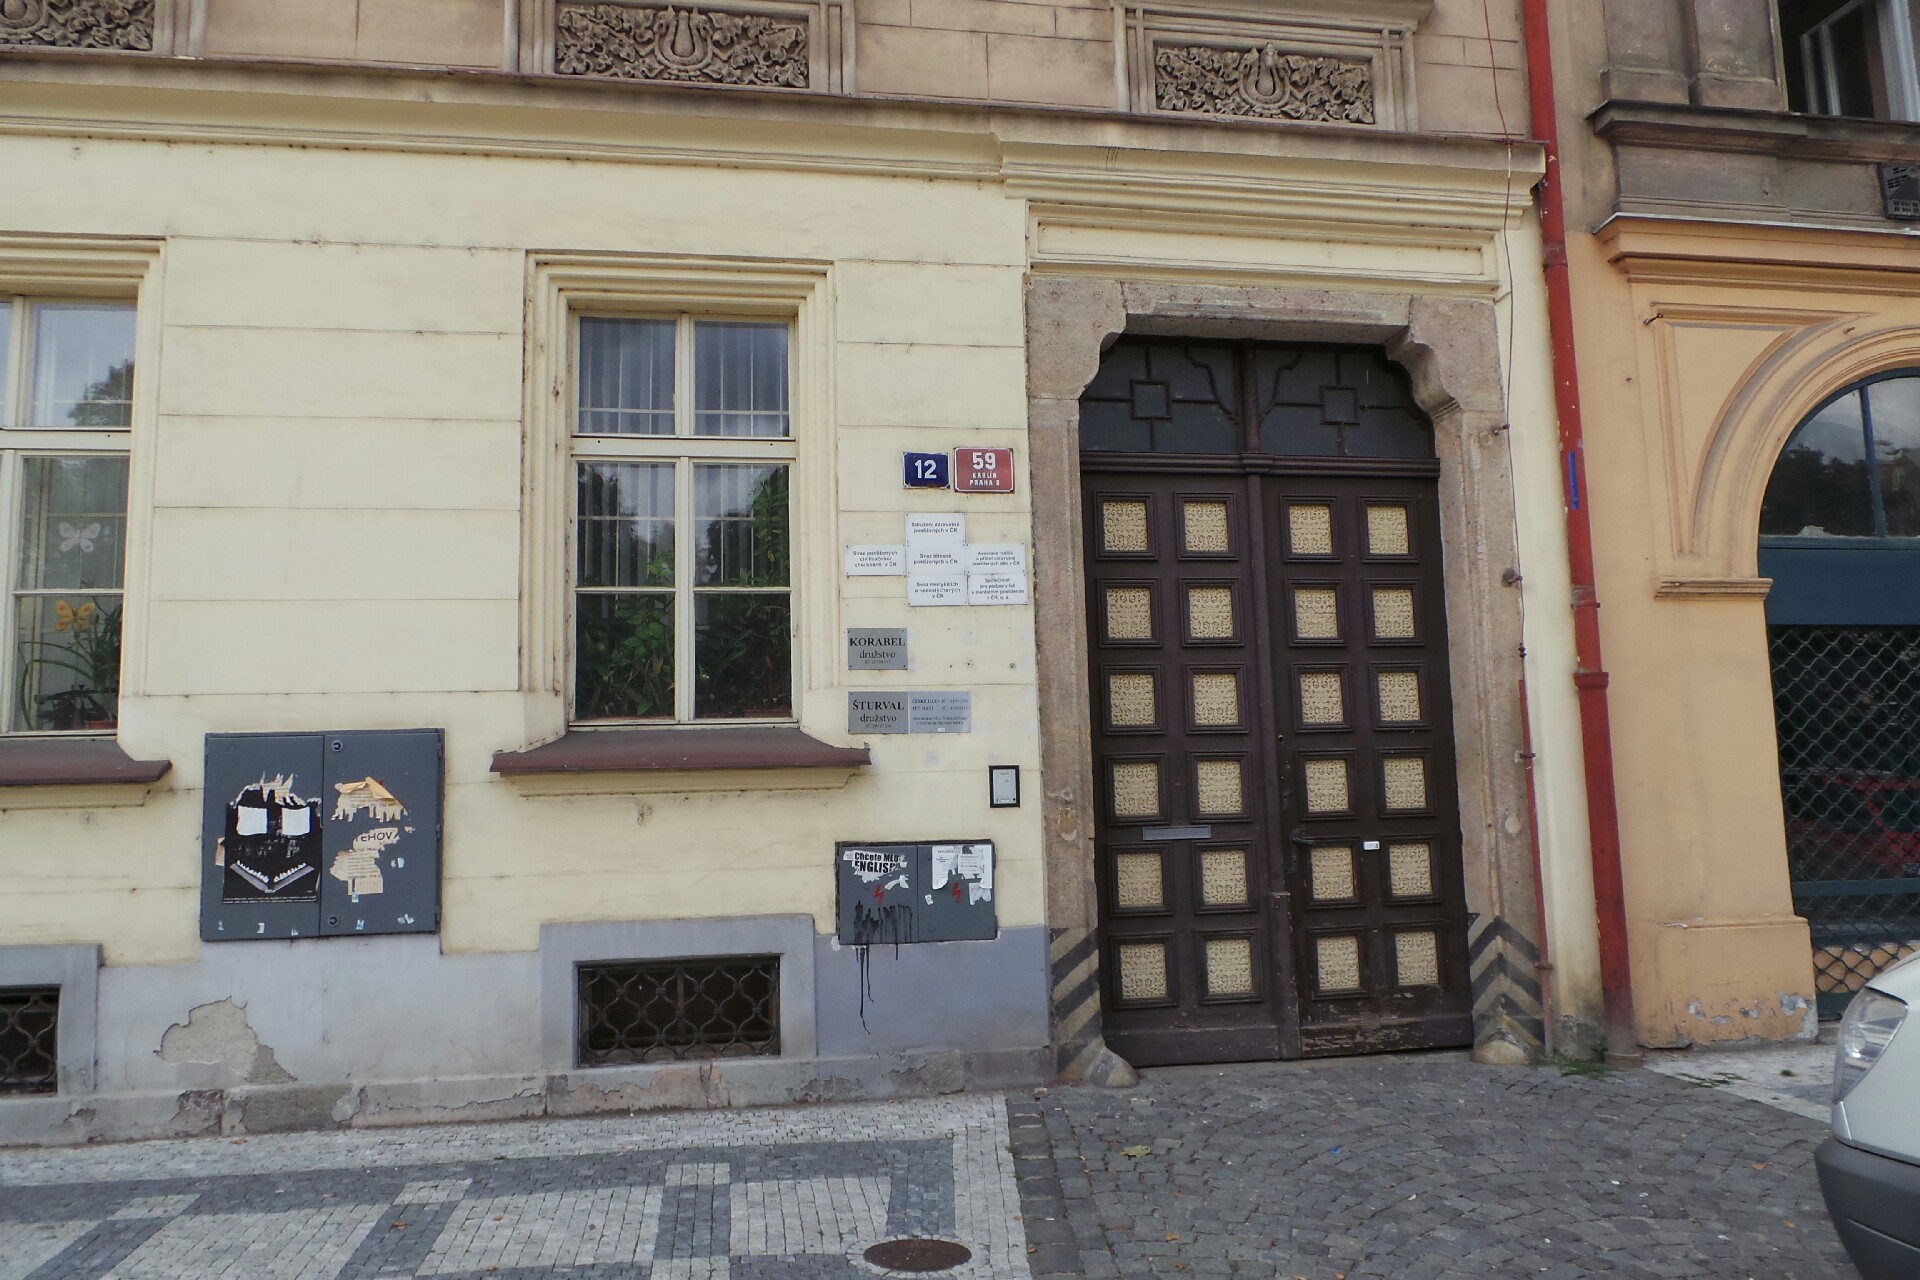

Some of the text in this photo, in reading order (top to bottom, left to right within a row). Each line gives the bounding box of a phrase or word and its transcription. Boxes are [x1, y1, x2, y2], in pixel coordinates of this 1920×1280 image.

[972, 452, 996, 470] 59
[915, 460, 937, 479] 12
[849, 637, 905, 646] KORABEL
[860, 650, 896, 658] družstvo
[852, 699, 904, 710] ŠTURVAL
[860, 714, 897, 722] družstvo
[855, 852, 882, 861] Chcete
